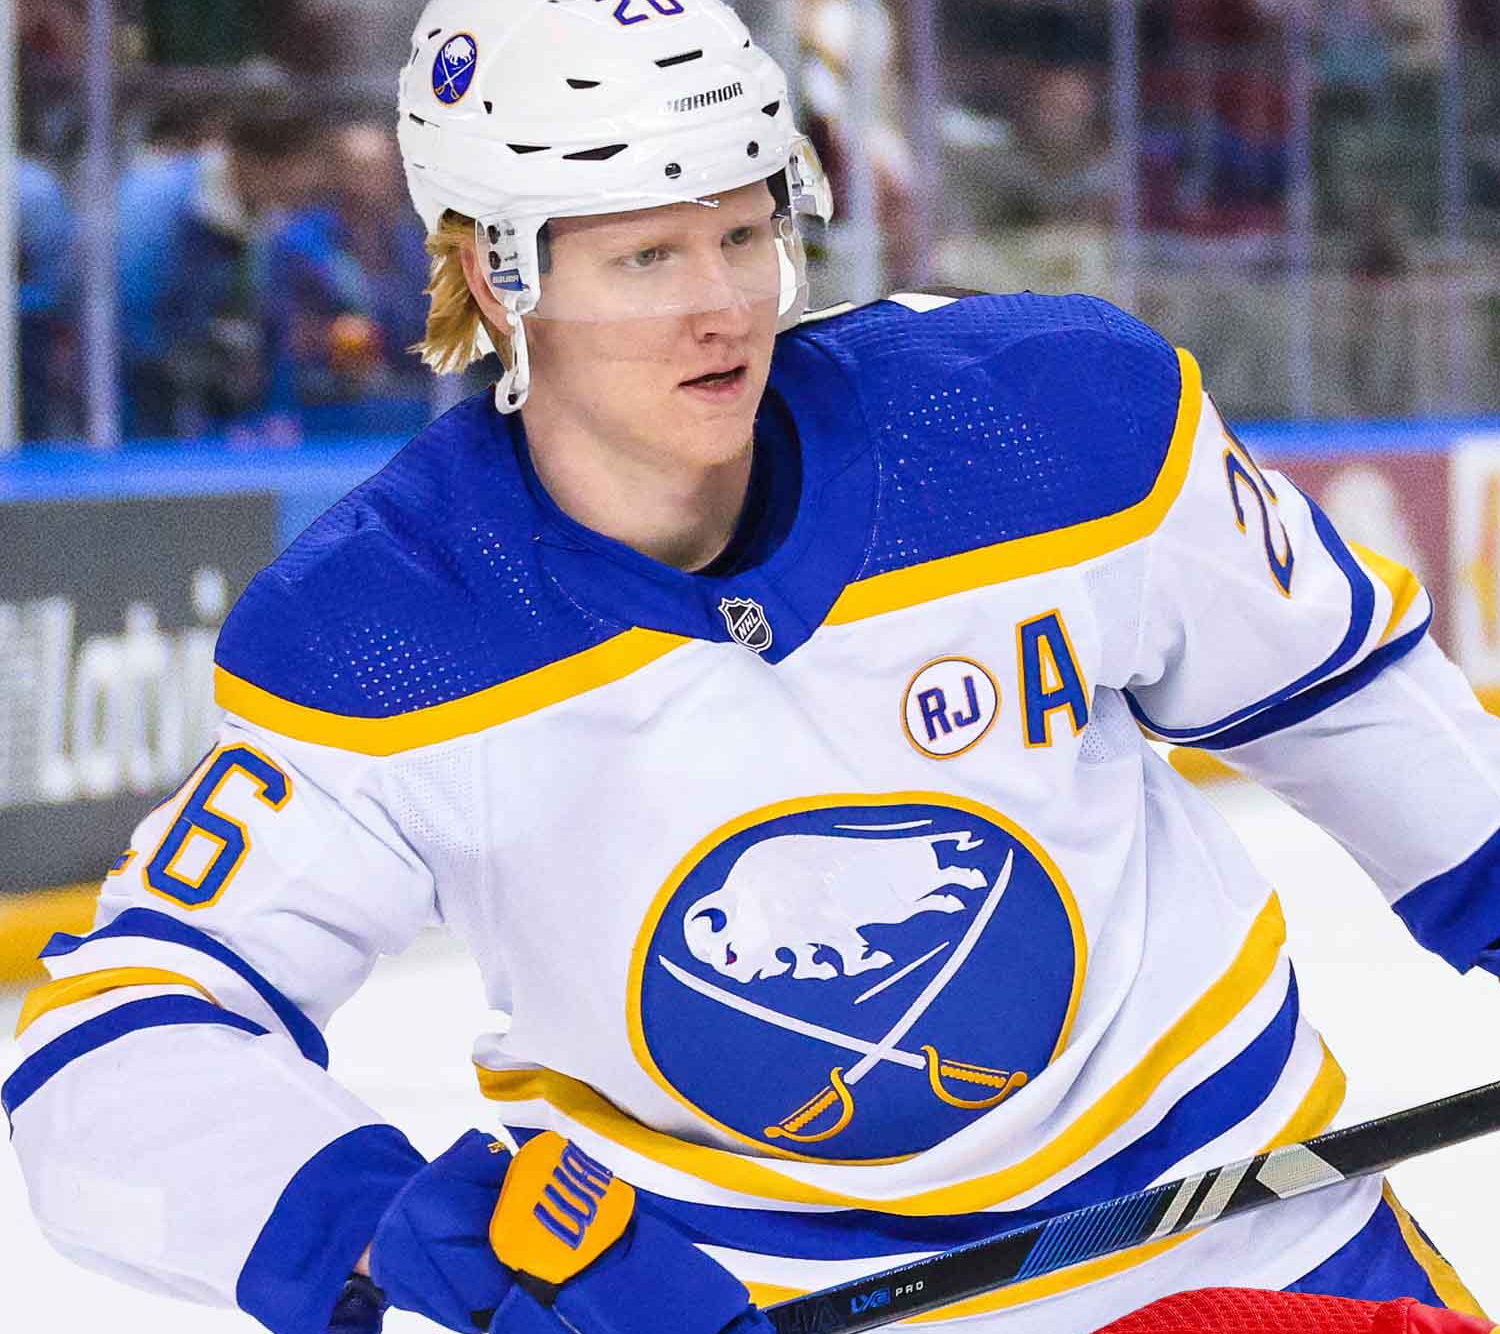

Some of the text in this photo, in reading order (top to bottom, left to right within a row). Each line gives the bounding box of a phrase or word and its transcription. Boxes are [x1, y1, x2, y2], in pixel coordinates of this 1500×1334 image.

[738, 610, 760, 641] NHL
[1015, 607, 1091, 749] A
[917, 676, 981, 743] RJ
[895, 1280, 925, 1297] PRO
